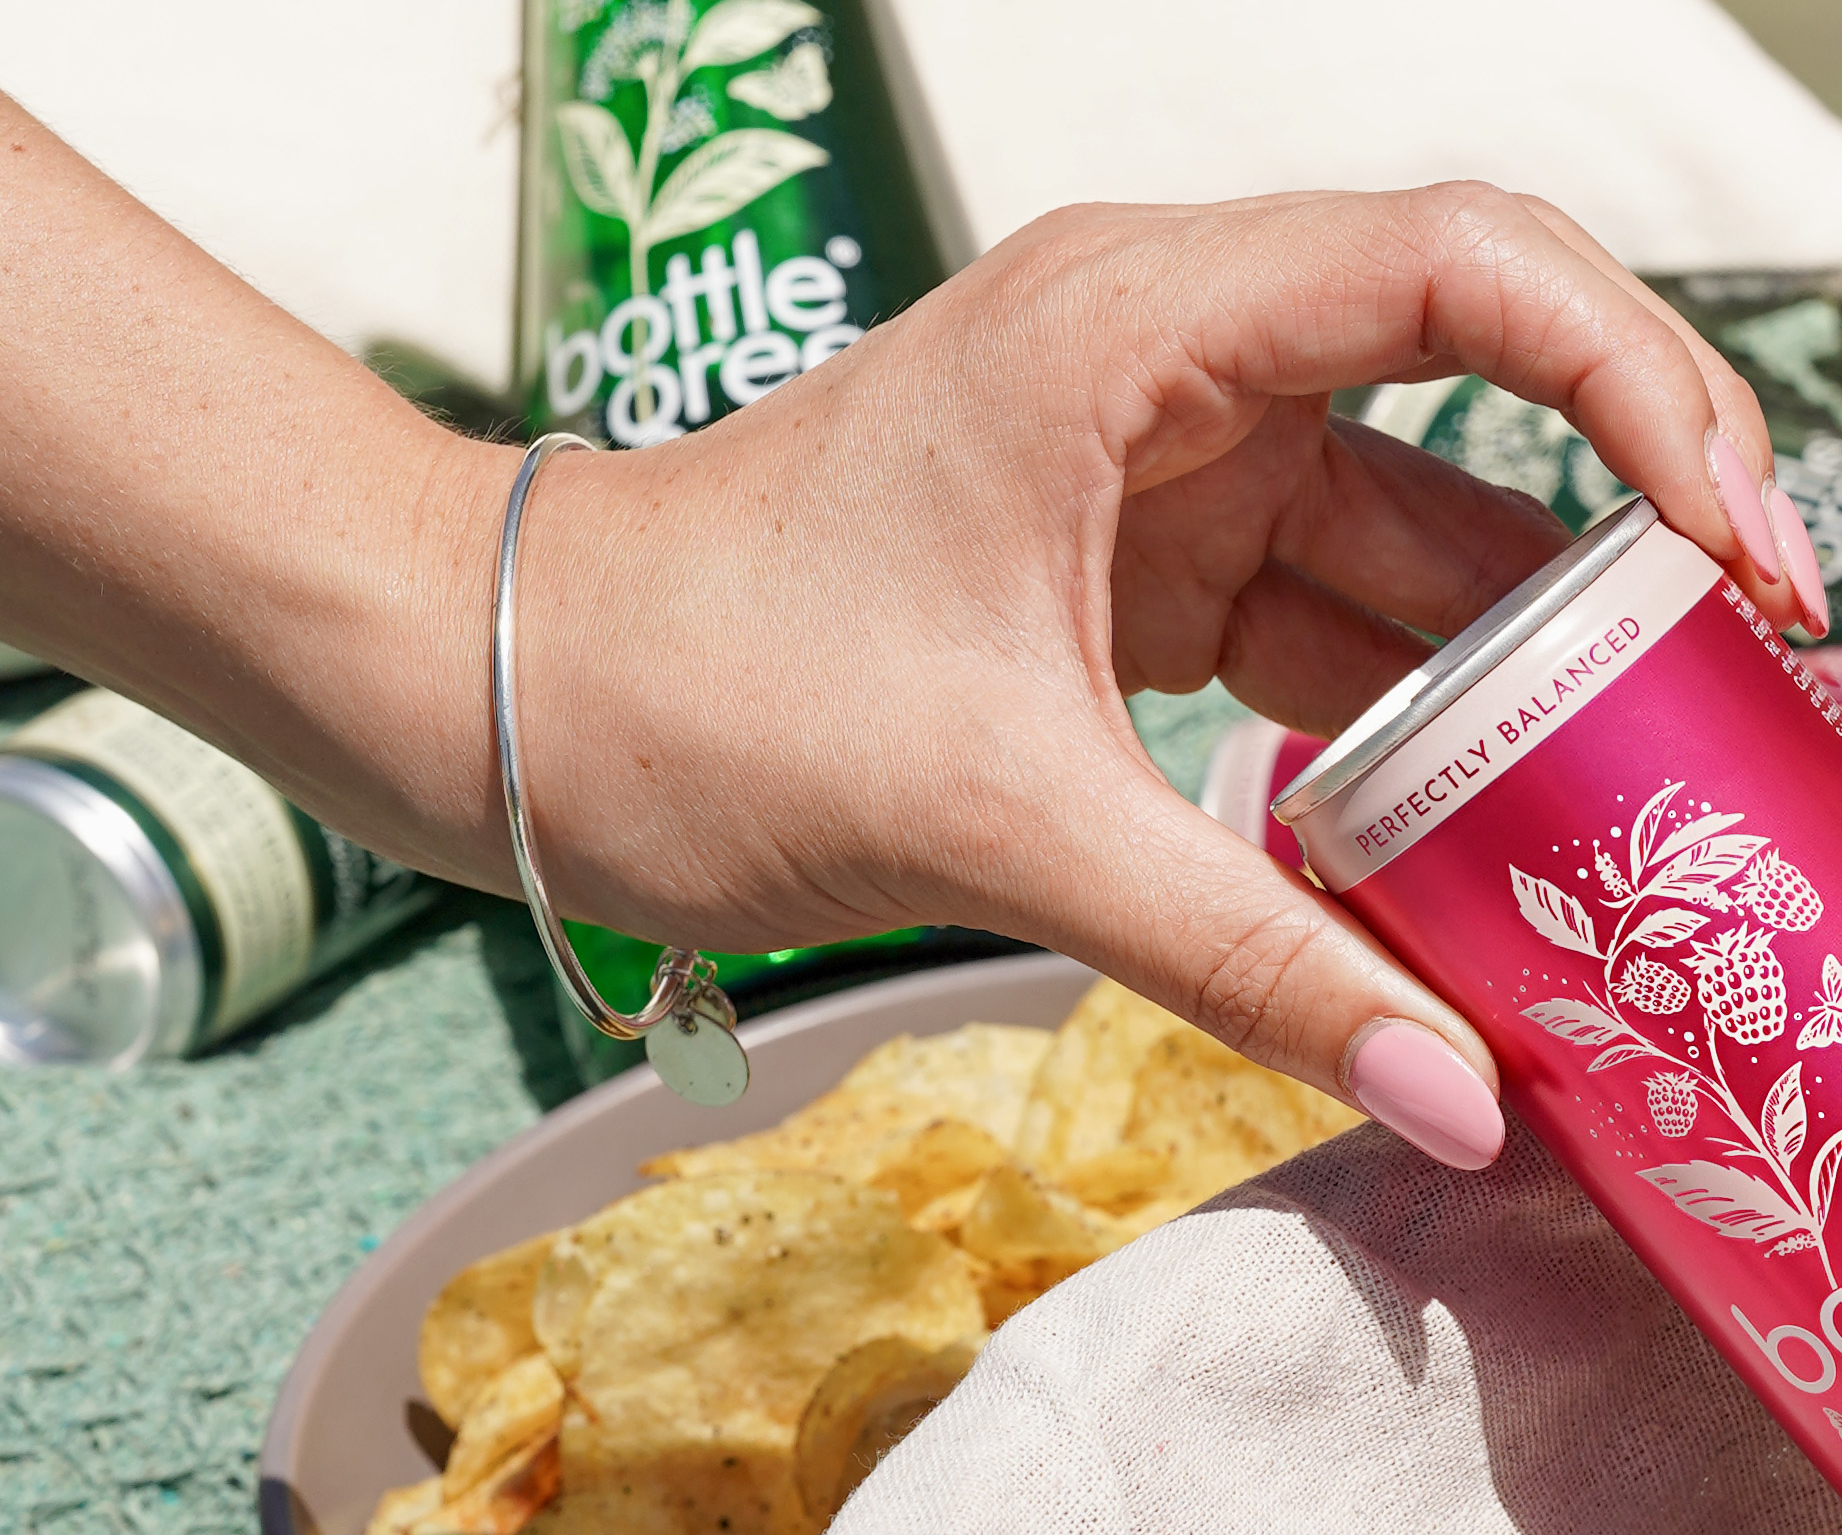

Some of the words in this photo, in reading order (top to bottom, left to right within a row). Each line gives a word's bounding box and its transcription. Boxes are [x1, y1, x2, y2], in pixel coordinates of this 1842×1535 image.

[545, 228, 846, 417] bottle
[1355, 740, 1492, 857] PERFECTLY
[1497, 616, 1641, 745] BALANCED
